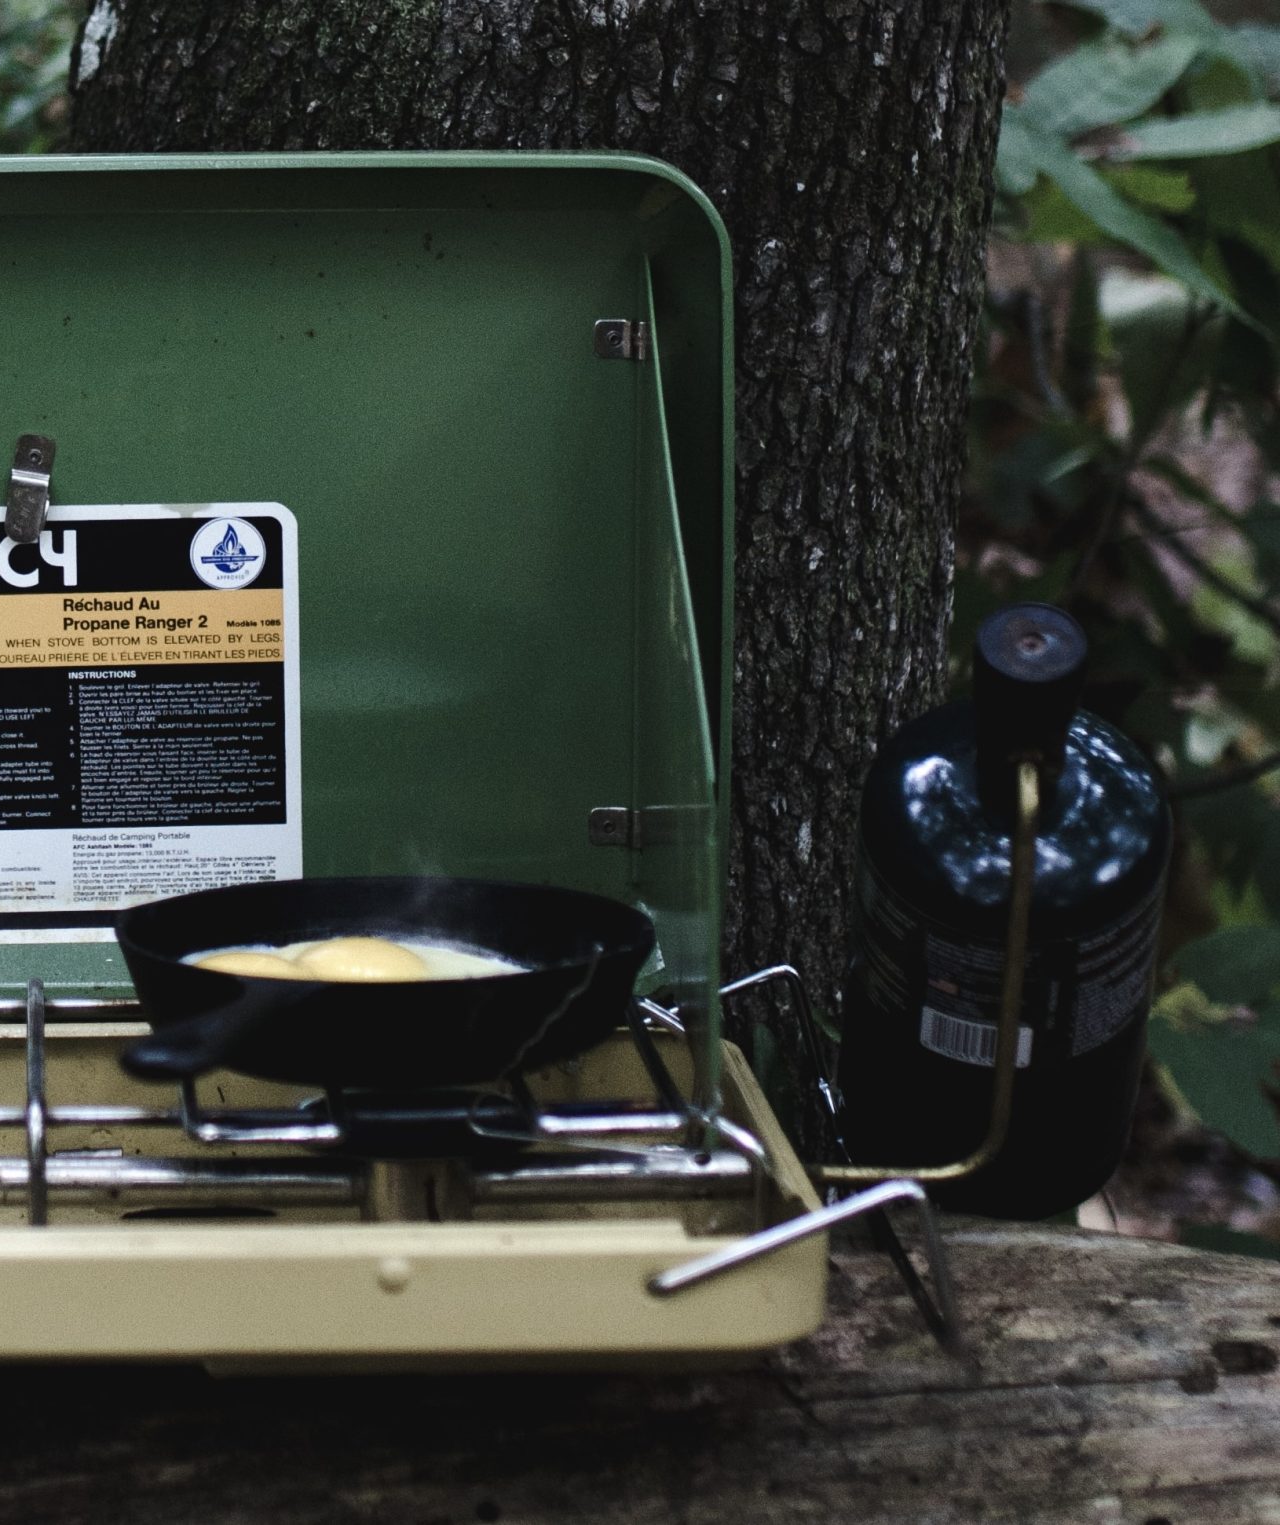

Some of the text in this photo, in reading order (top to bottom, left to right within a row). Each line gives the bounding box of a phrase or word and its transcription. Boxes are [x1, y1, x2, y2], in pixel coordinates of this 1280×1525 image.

[63, 596, 159, 611] Réchaud Au
[63, 614, 207, 632] Propane Ranger 2
[5, 638, 40, 647] WHEN
[47, 637, 83, 647] STOVE
[92, 636, 140, 646] BOTTOM
[146, 635, 157, 644] IS
[164, 634, 220, 644] ELEVATED
[227, 633, 242, 643] BY
[250, 632, 282, 642] LEGS.
[92, 652, 106, 661] DE
[165, 650, 180, 660] EN
[182, 649, 222, 658] TIRANT
[224, 648, 245, 658] LES
[68, 670, 136, 679] INSTRUCTIONS
[120, 833, 155, 841] Camping
